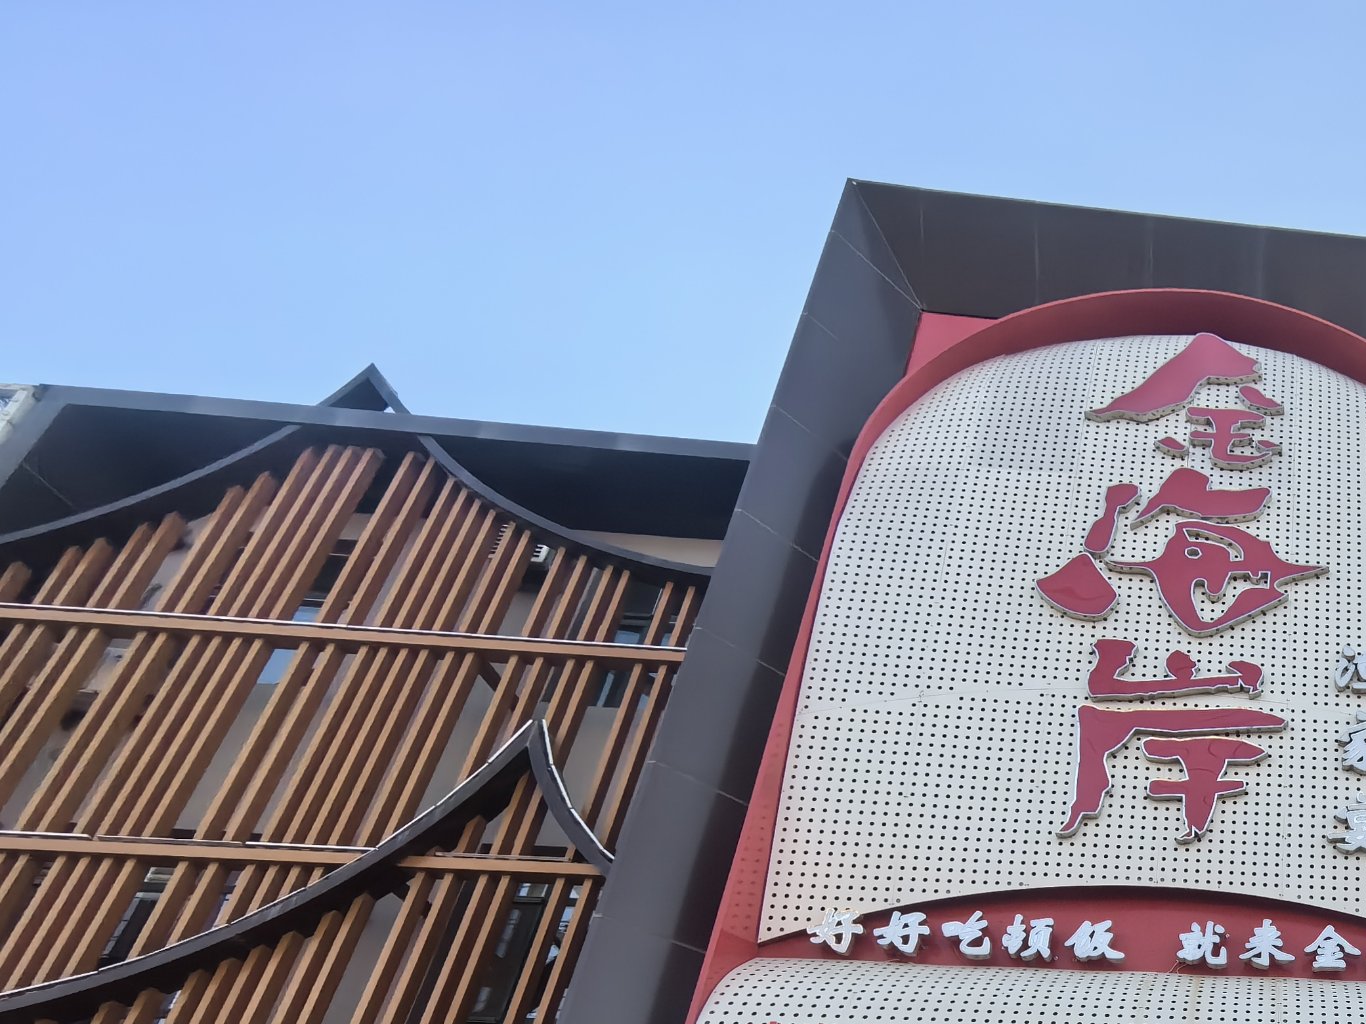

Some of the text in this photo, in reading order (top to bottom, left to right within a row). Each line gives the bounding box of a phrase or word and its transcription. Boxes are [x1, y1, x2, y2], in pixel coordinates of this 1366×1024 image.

[1034, 332, 1330, 845] 金海岸
[807, 907, 1126, 964] 好好吃顿饭
